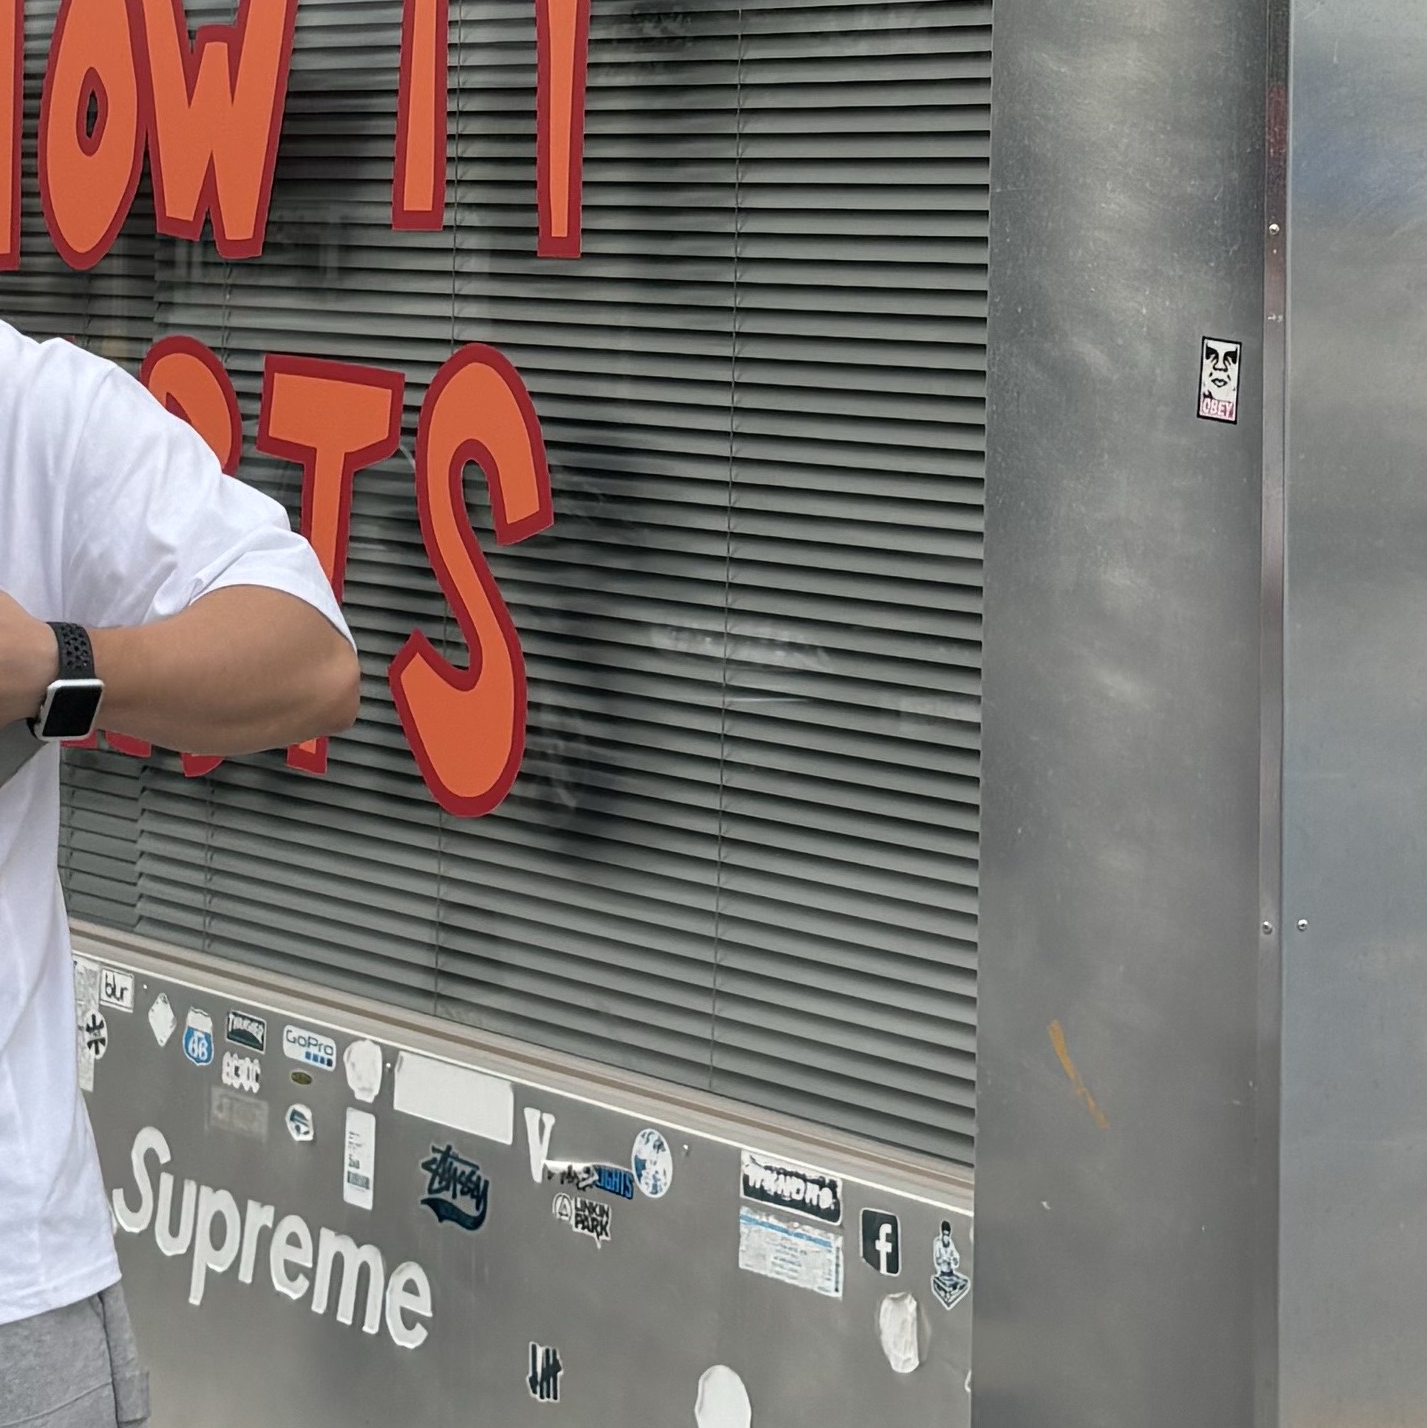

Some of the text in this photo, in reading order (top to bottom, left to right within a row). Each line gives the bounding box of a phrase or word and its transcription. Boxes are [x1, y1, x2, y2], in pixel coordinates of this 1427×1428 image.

[1202, 398, 1235, 419] OBEY
[104, 975, 128, 1002] blur
[286, 1029, 334, 1056] GoPro
[574, 1197, 610, 1218] LINKIN
[112, 1126, 433, 1349] Supreme
[574, 1212, 610, 1240] PARK
